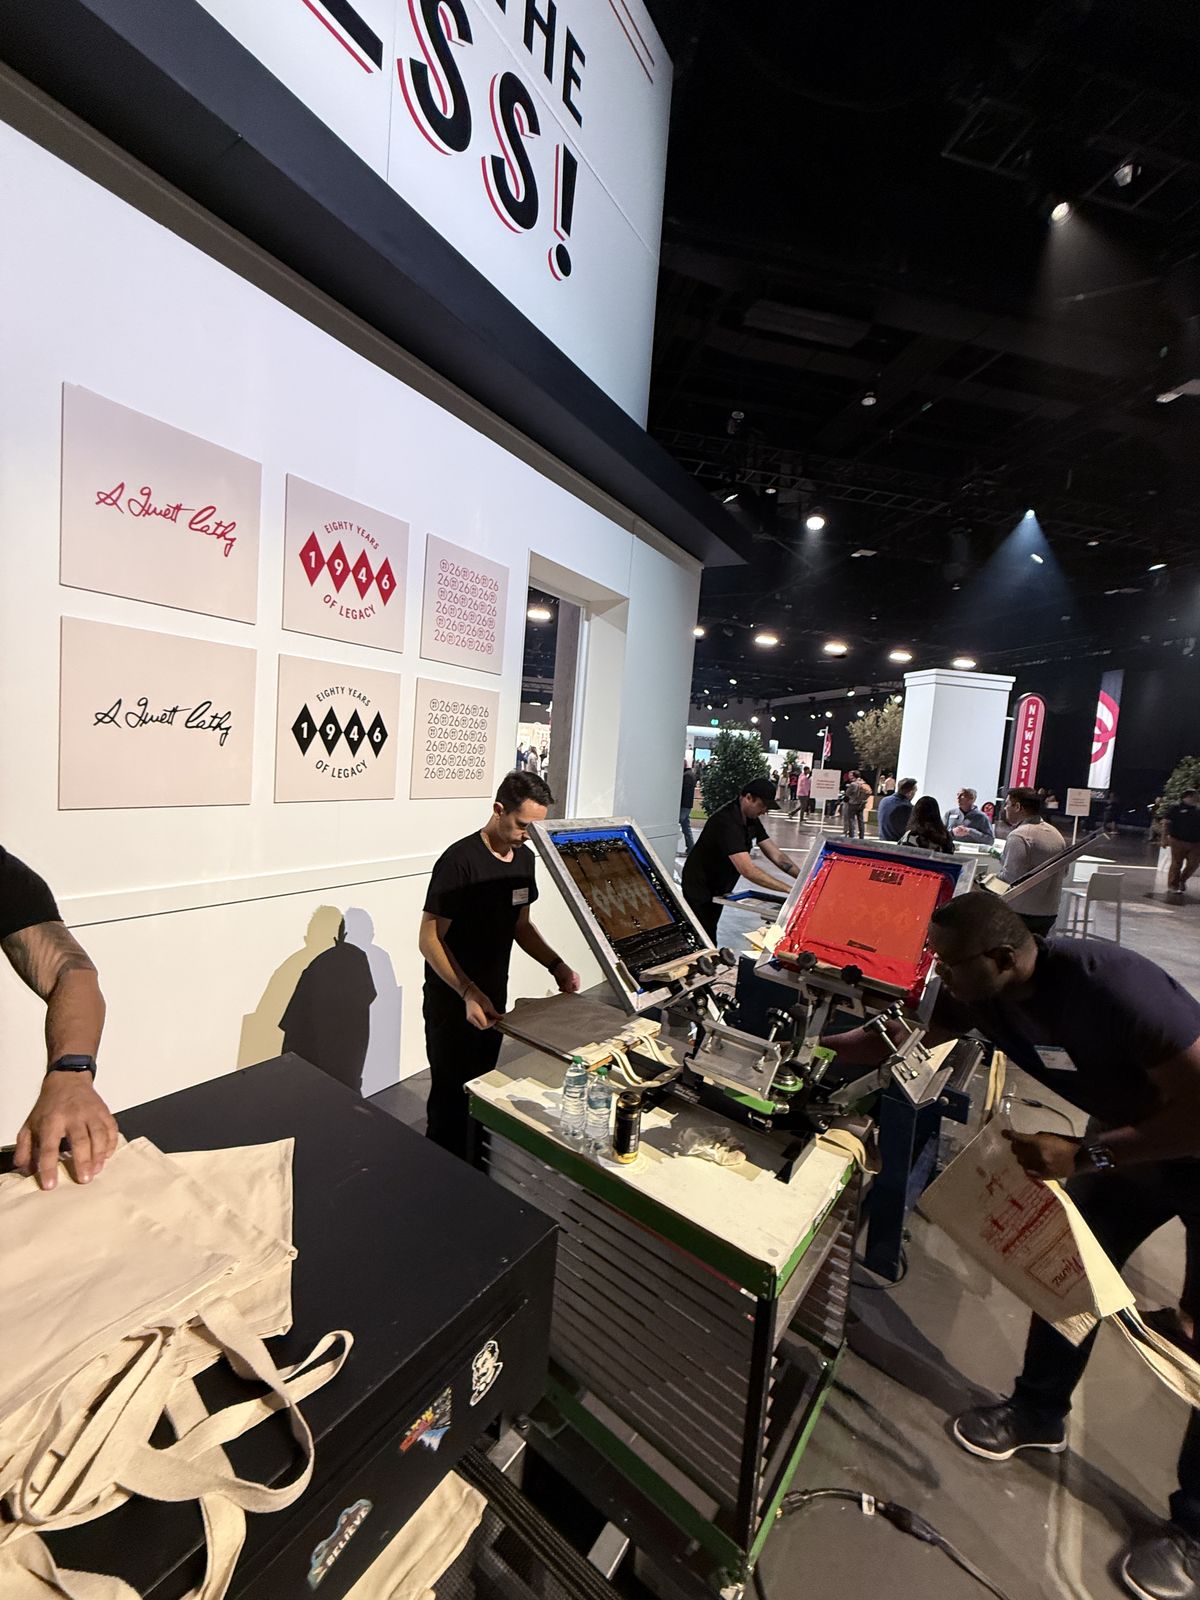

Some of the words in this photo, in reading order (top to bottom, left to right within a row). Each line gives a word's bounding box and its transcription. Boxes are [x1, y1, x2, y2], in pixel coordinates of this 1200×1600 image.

[496, 0, 586, 128] HE
[305, 0, 578, 281] SS!
[324, 520, 354, 534] EIGHTY
[356, 526, 380, 550] YEARS
[323, 594, 338, 608] OF
[339, 604, 376, 620] LEGACY
[316, 686, 345, 702] EIGHTY
[348, 688, 371, 706] YEARS
[315, 760, 330, 773] OF
[331, 760, 368, 778] LEGACY
